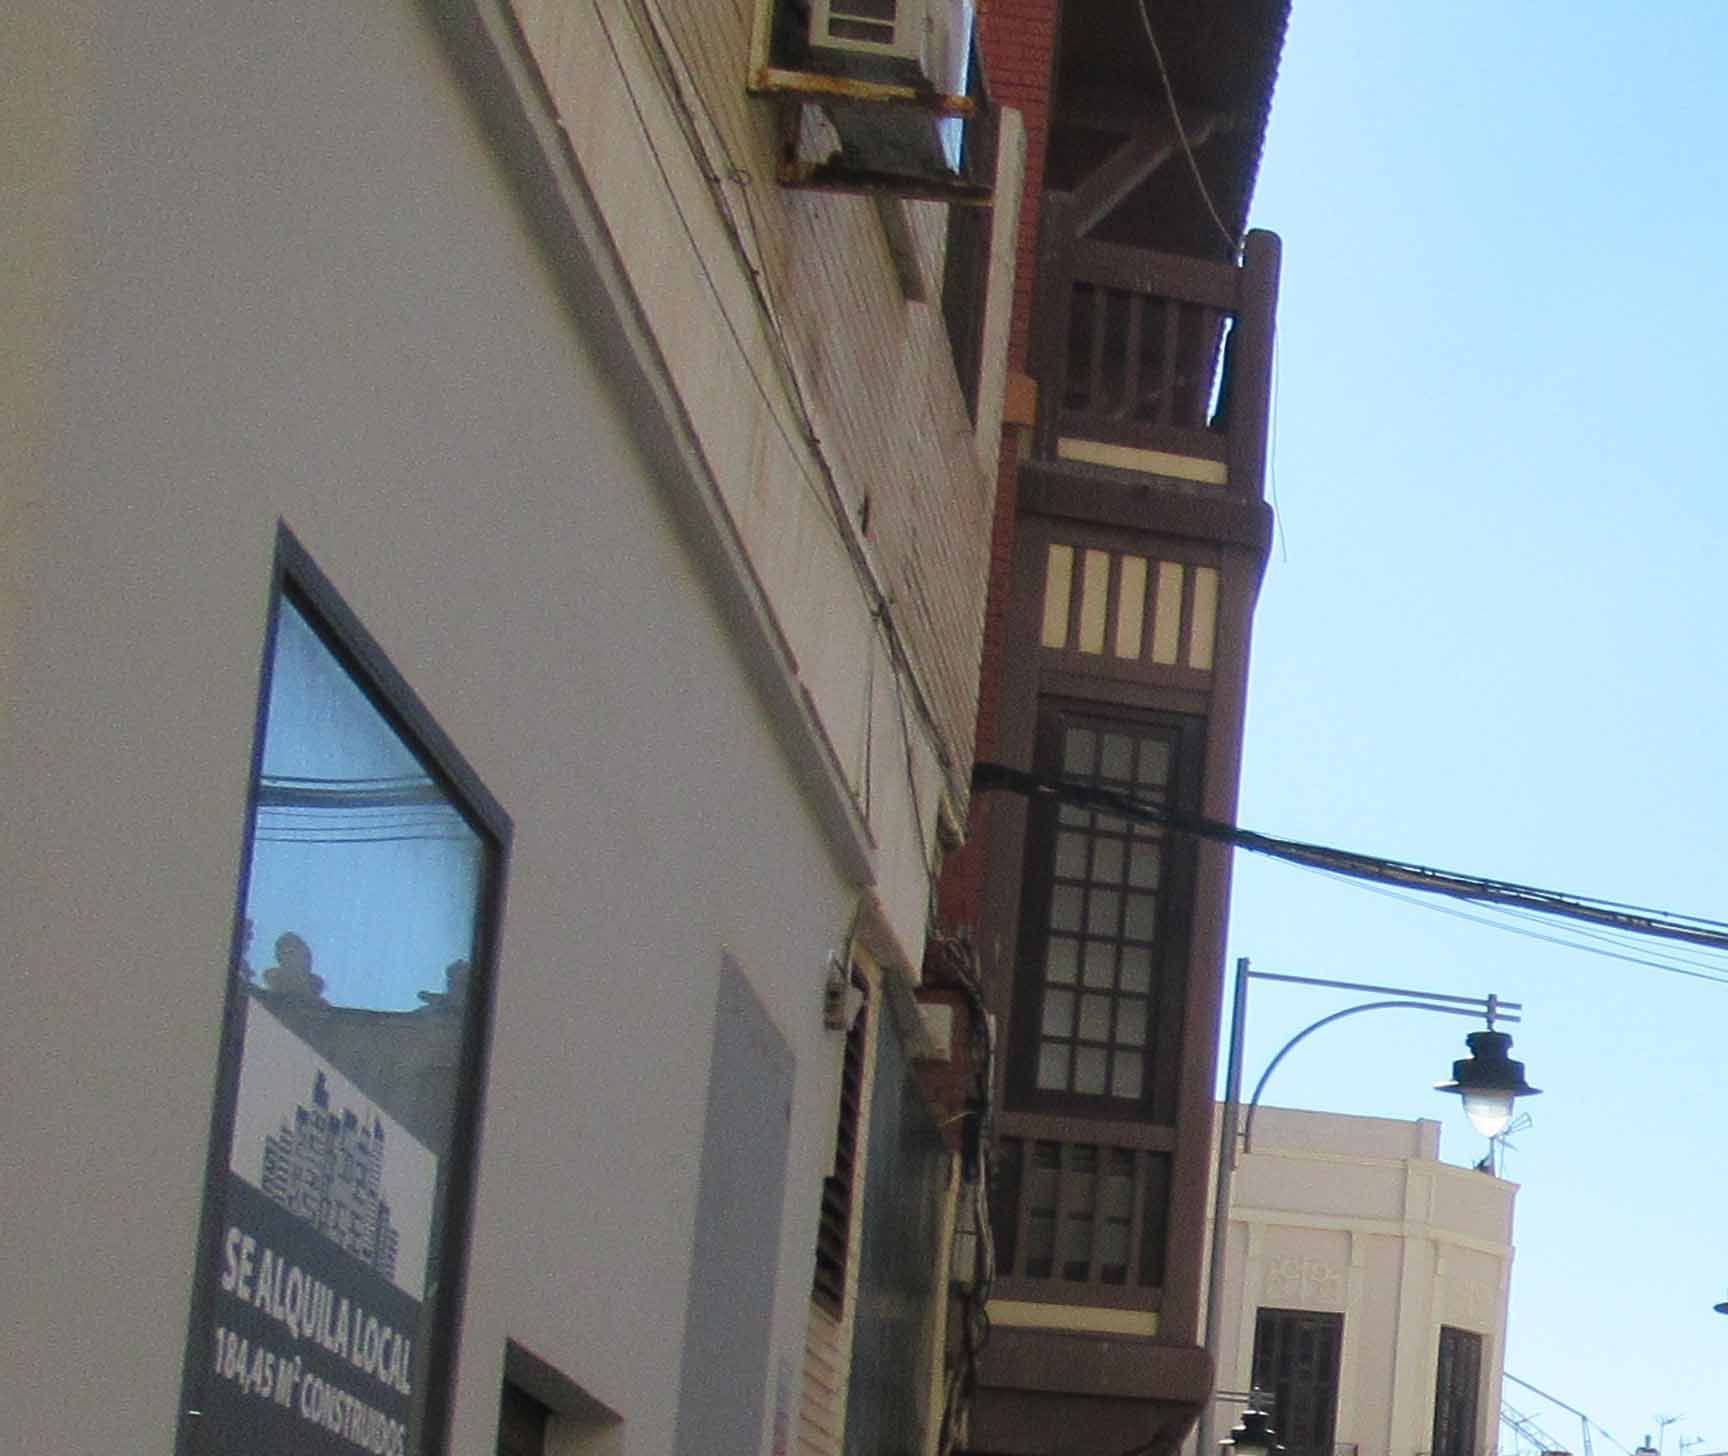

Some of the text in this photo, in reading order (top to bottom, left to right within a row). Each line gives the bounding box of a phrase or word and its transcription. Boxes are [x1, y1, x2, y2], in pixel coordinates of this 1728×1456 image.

[221, 1226, 411, 1396] SE ALQUILA LOCAL
